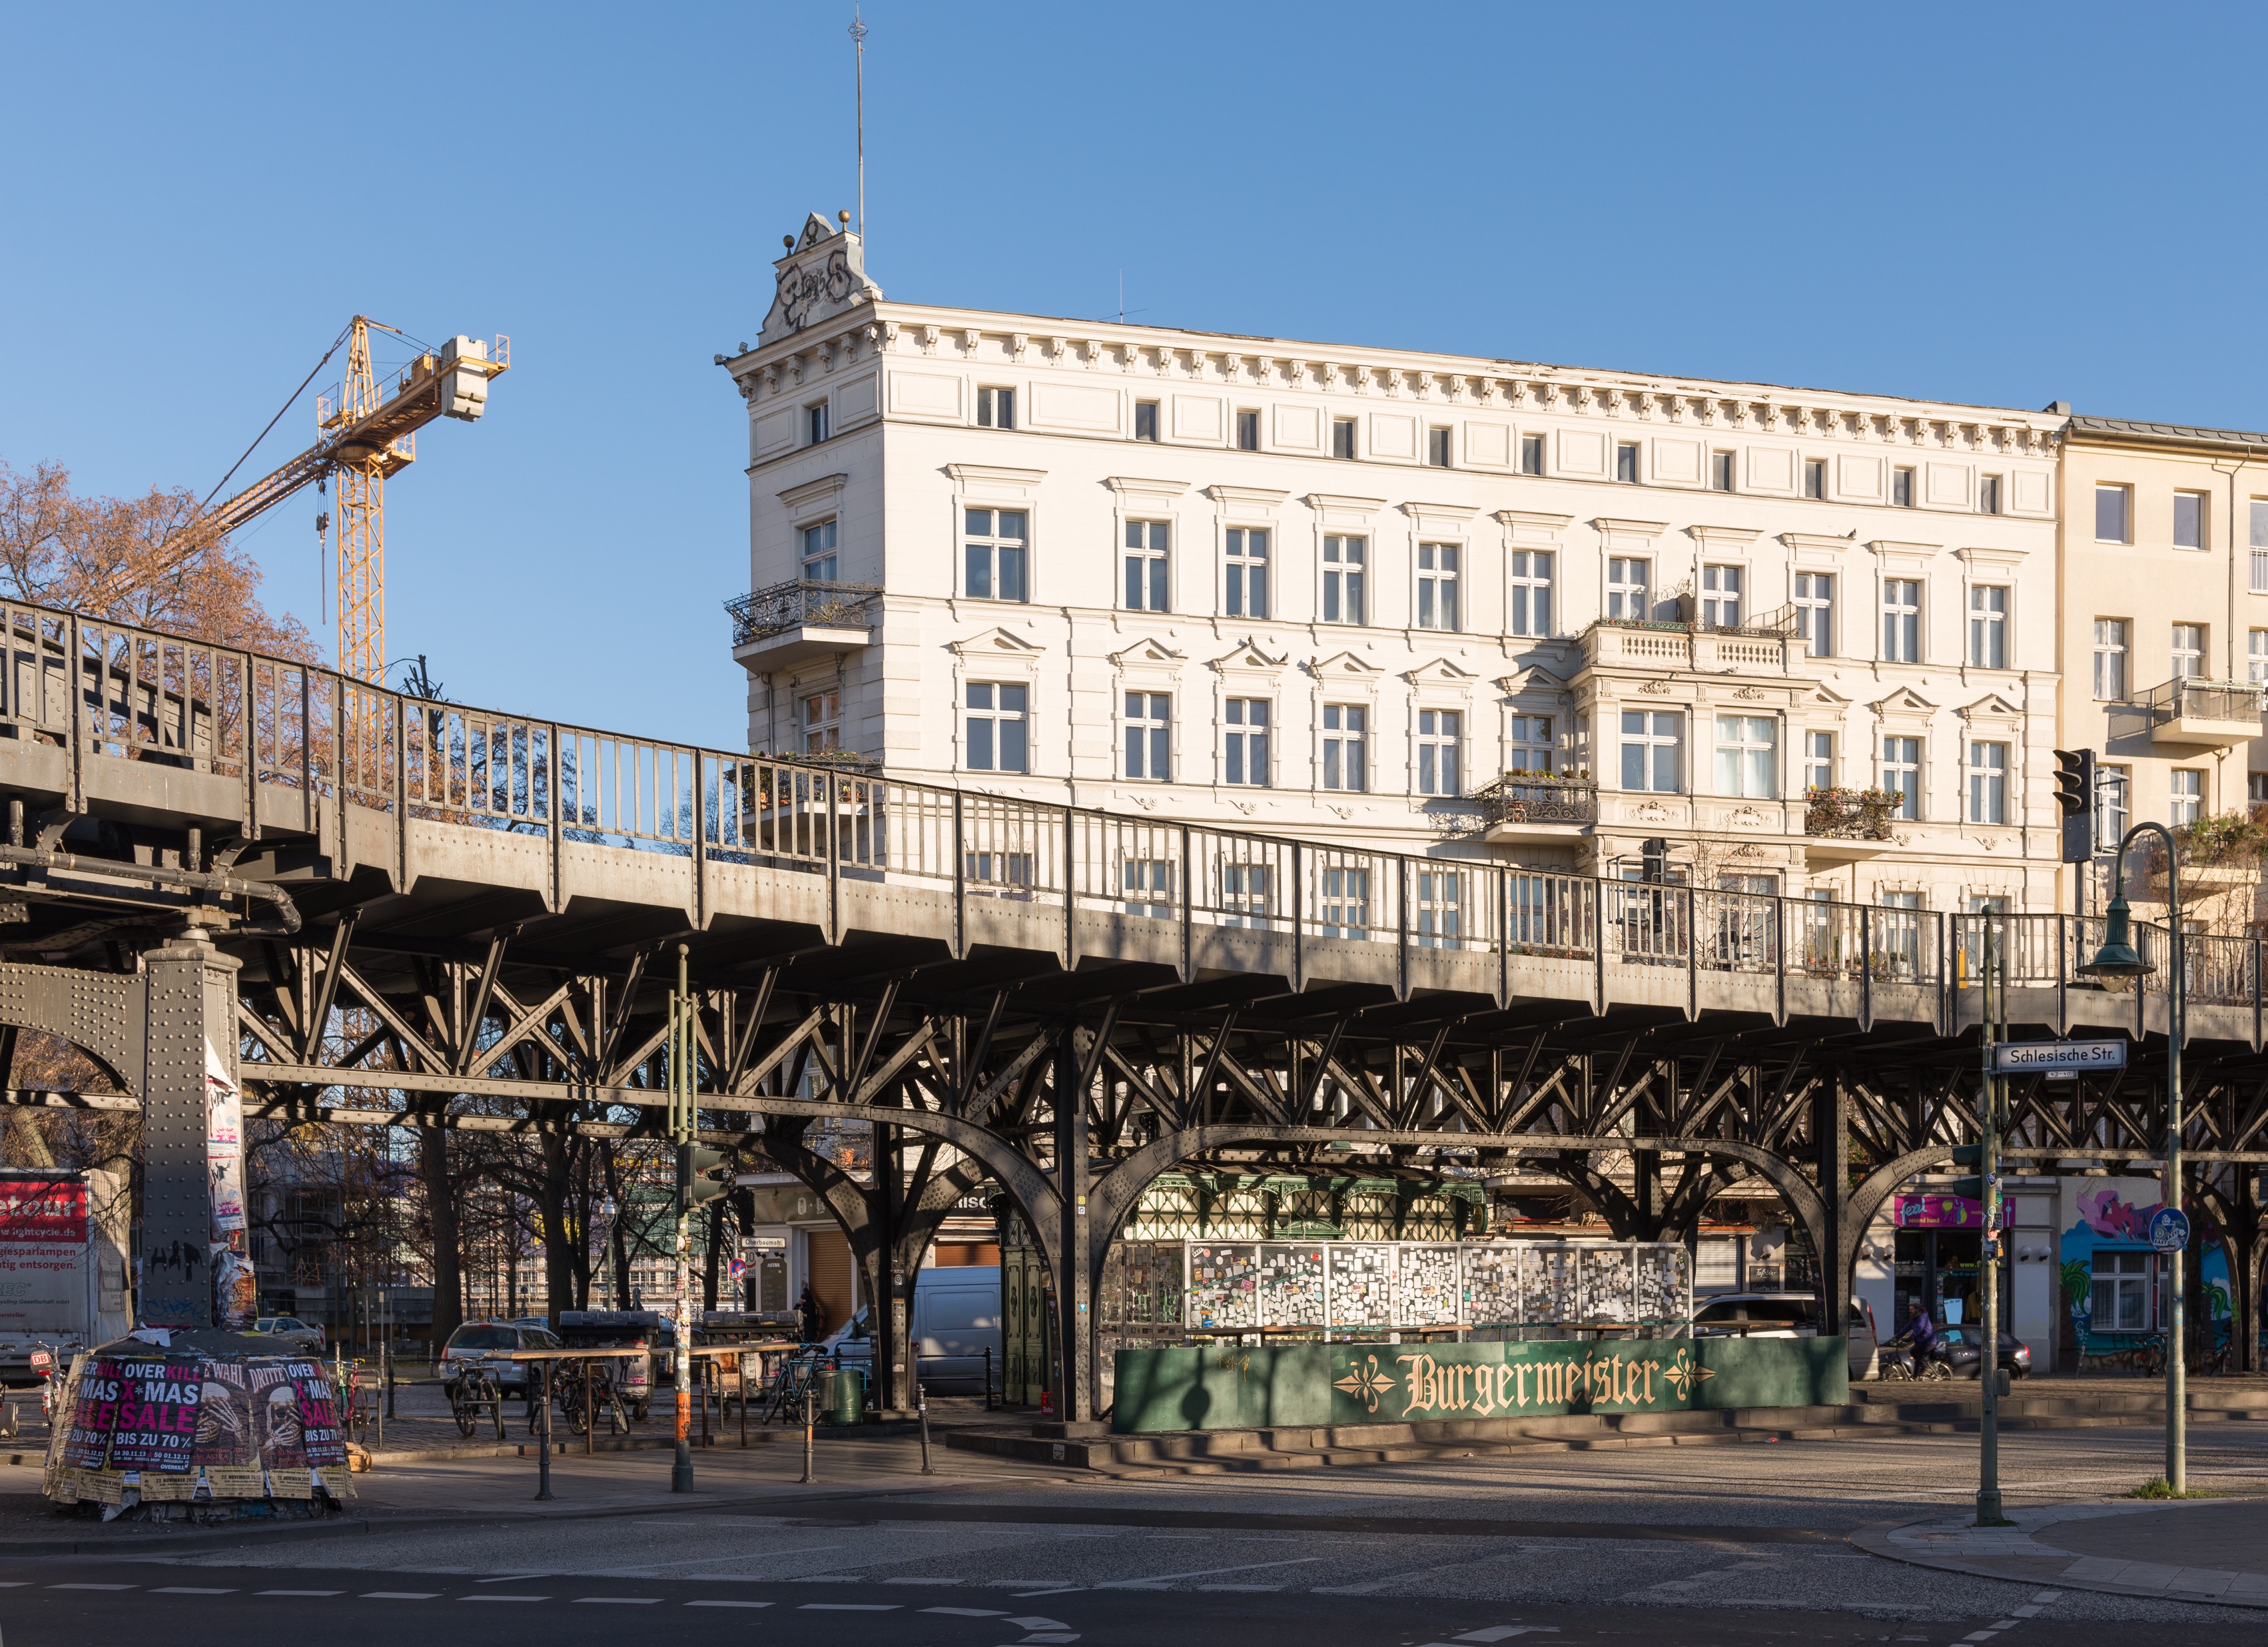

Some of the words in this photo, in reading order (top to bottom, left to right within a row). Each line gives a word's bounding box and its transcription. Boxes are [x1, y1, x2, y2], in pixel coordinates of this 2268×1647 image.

[2010, 1048, 2088, 1063] Schlesische
[2092, 1047, 2115, 1061] Str.
[0, 1260, 16, 1271] tig
[19, 1260, 76, 1271] entsorgen.
[1756, 1268, 1777, 1277] Faßbier
[125, 1363, 202, 1382] OVERKILL
[213, 1363, 246, 1390] WAHL
[248, 1367, 285, 1395] DRITTE
[1396, 1350, 1660, 1418] Burgermeister
[119, 1402, 197, 1433] SALE
[116, 1432, 137, 1445] BIS
[139, 1433, 158, 1446] ZU
[305, 1430, 319, 1442] BIS
[320, 1430, 329, 1441] ZU
